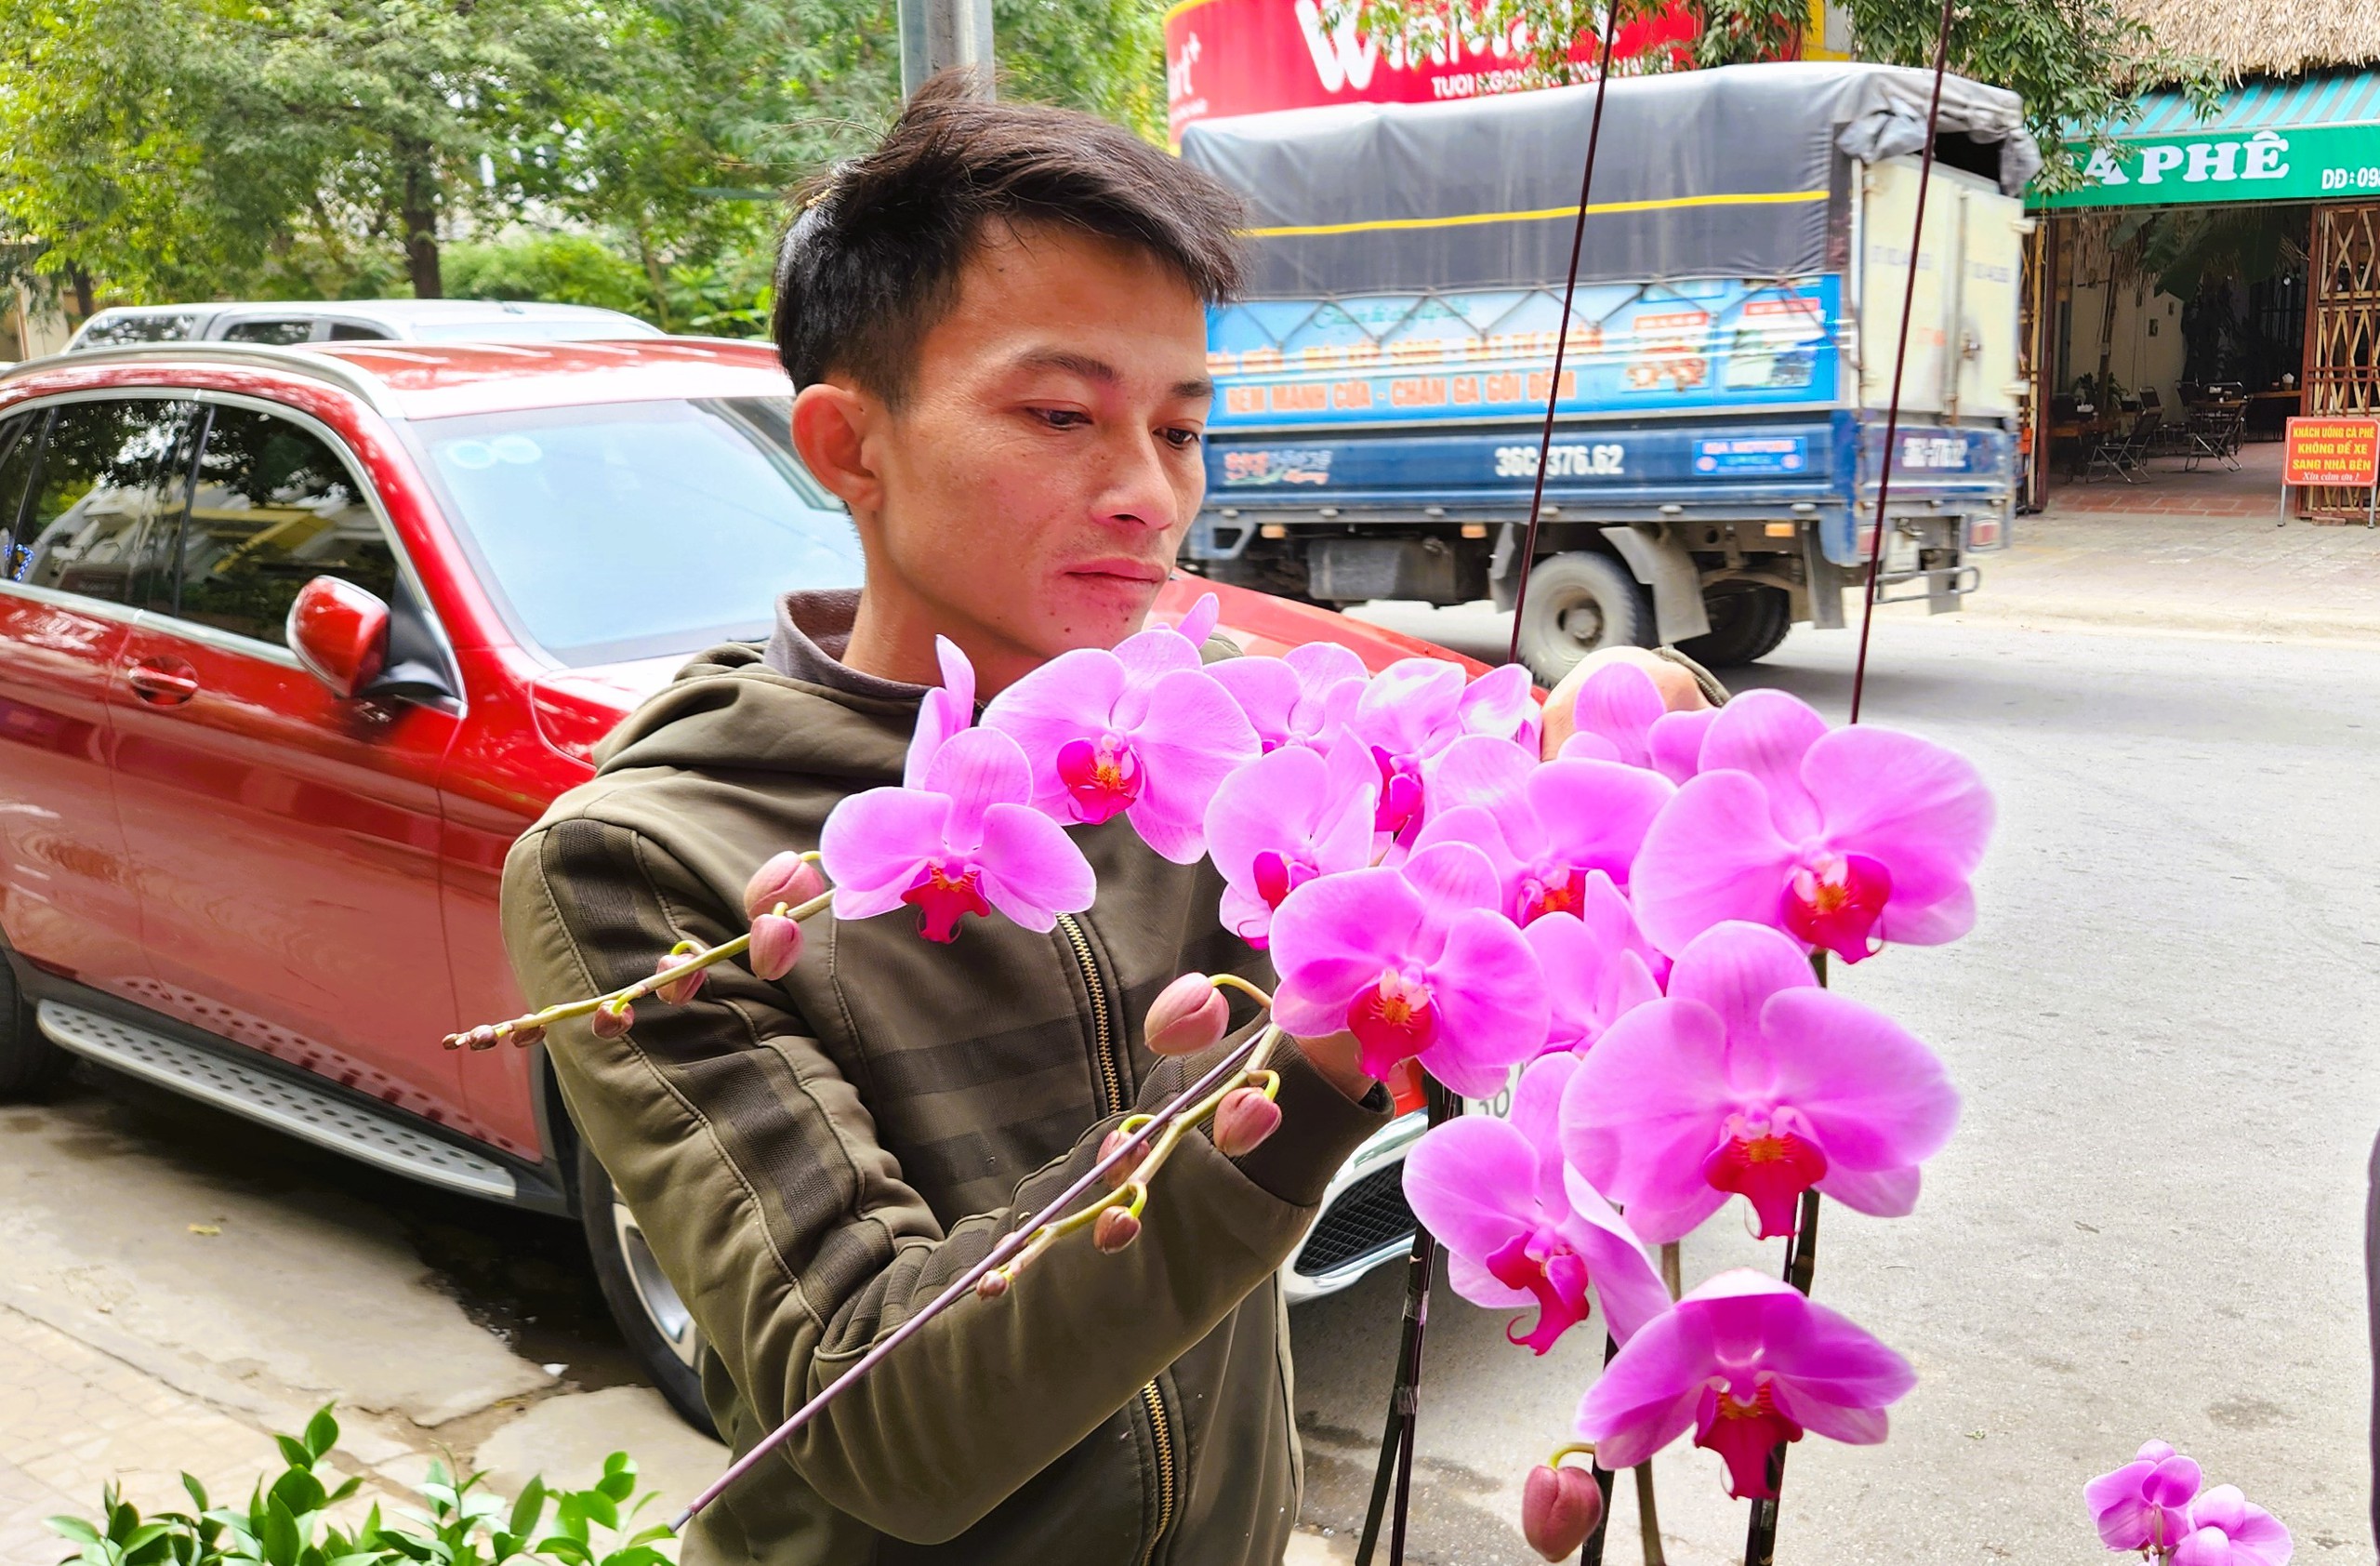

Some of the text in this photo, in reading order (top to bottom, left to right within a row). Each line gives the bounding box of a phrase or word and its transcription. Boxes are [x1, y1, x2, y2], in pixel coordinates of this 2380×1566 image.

[2137, 129, 2290, 184] PHÊ
[2293, 424, 2375, 439] KHÁCH UỐNG CÀ PHÊ
[2297, 439, 2368, 455] KHÔNG ĐỂ XE
[2292, 457, 2372, 471] SANG NHÀ BÊN
